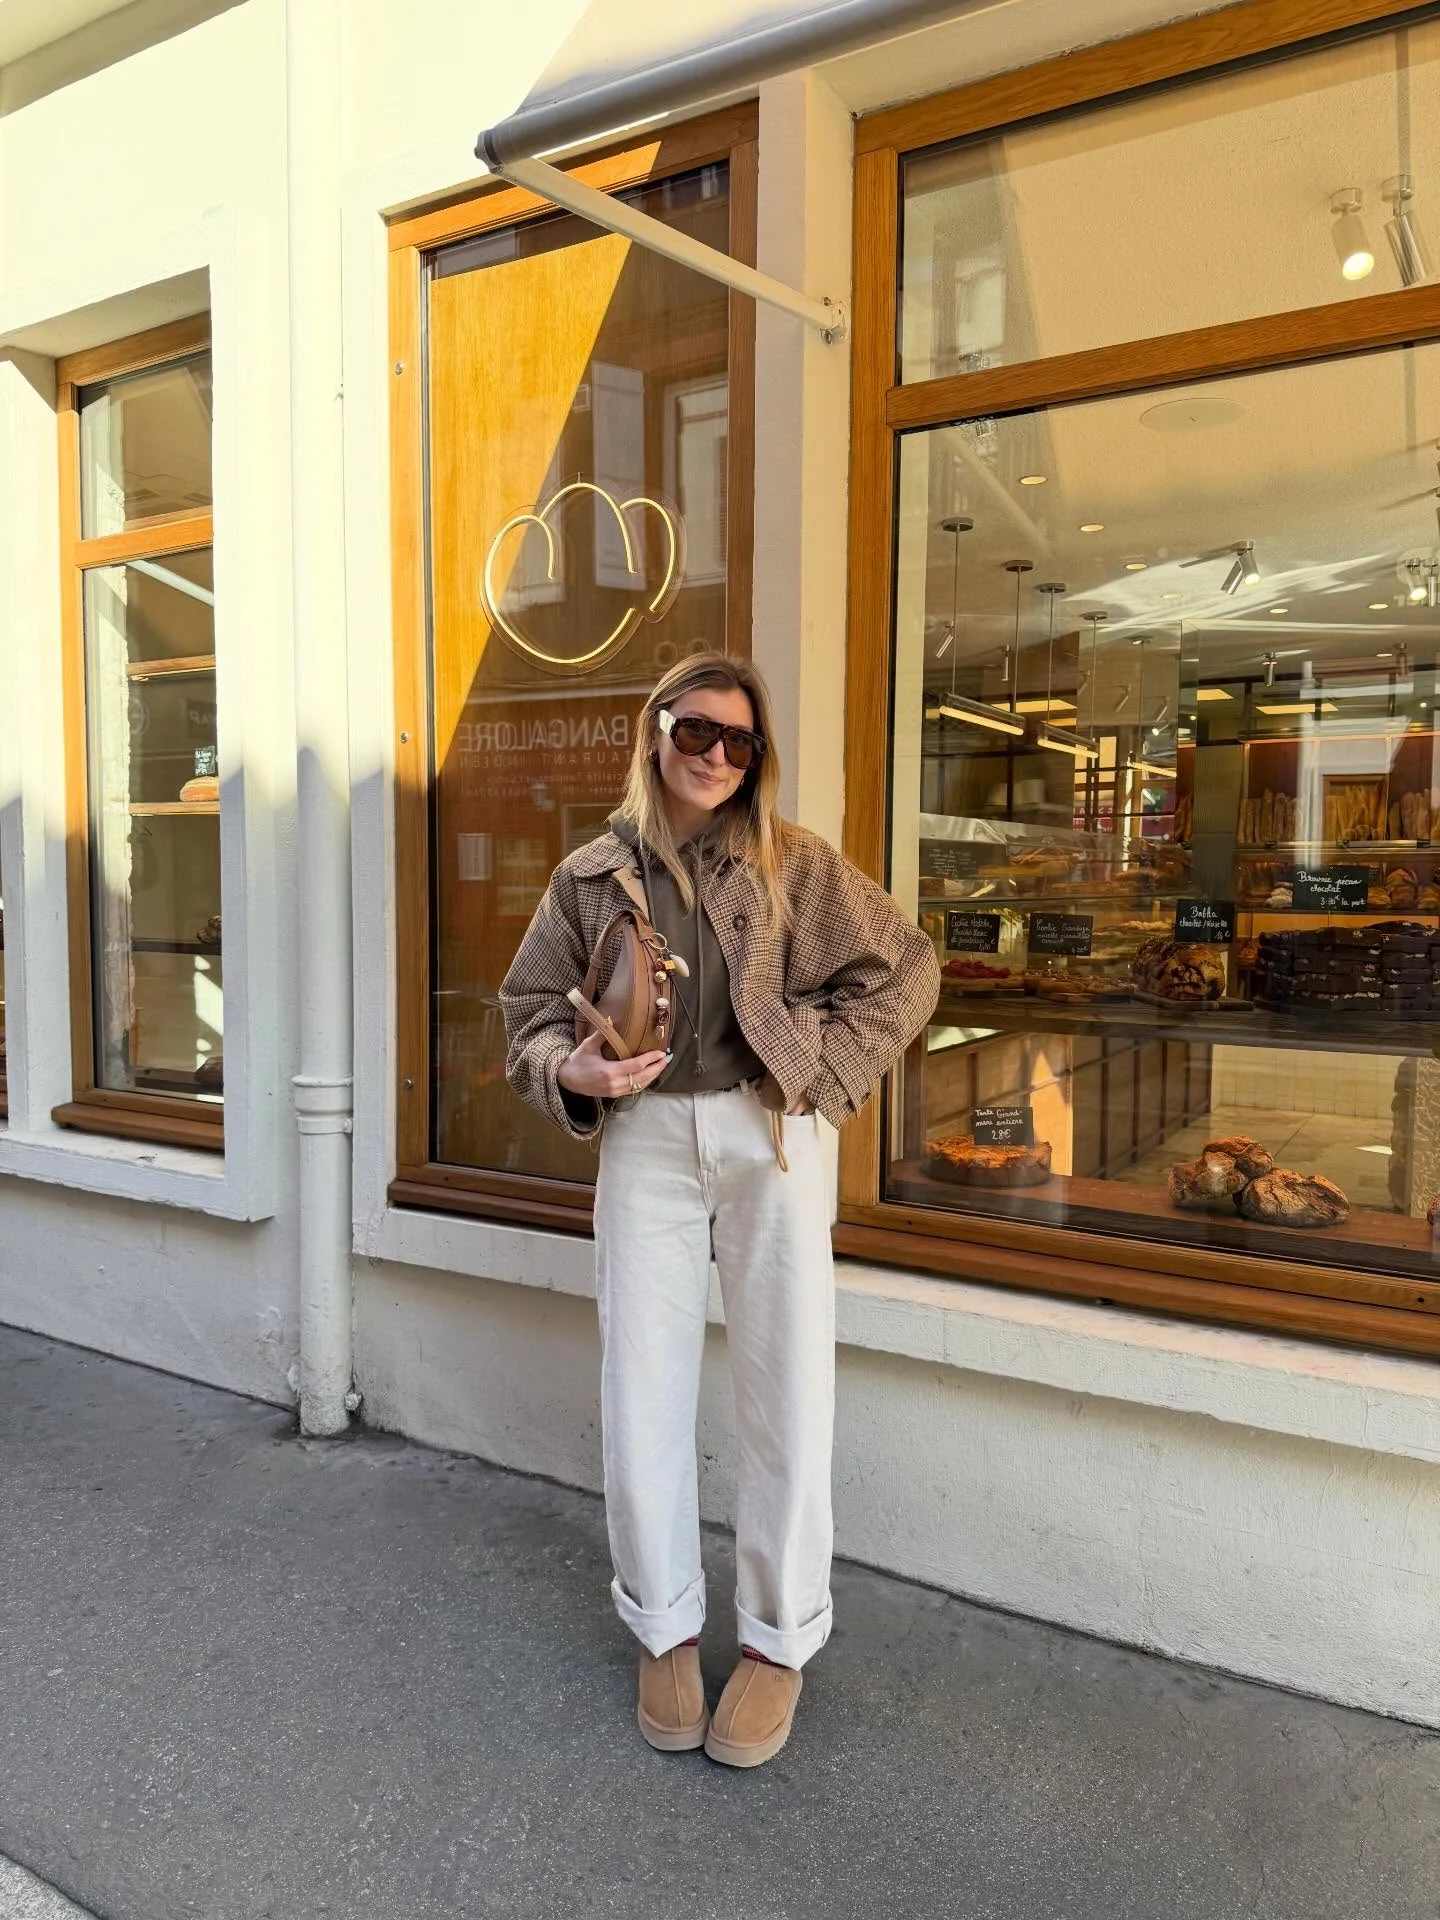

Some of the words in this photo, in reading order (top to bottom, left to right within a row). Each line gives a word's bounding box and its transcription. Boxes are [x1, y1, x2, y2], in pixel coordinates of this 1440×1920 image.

[1297, 871, 1333, 883] Brownie
[1310, 884, 1342, 893] chocolat
[974, 1109, 995, 1117] Tarte
[992, 1128, 1011, 1140] 28€
